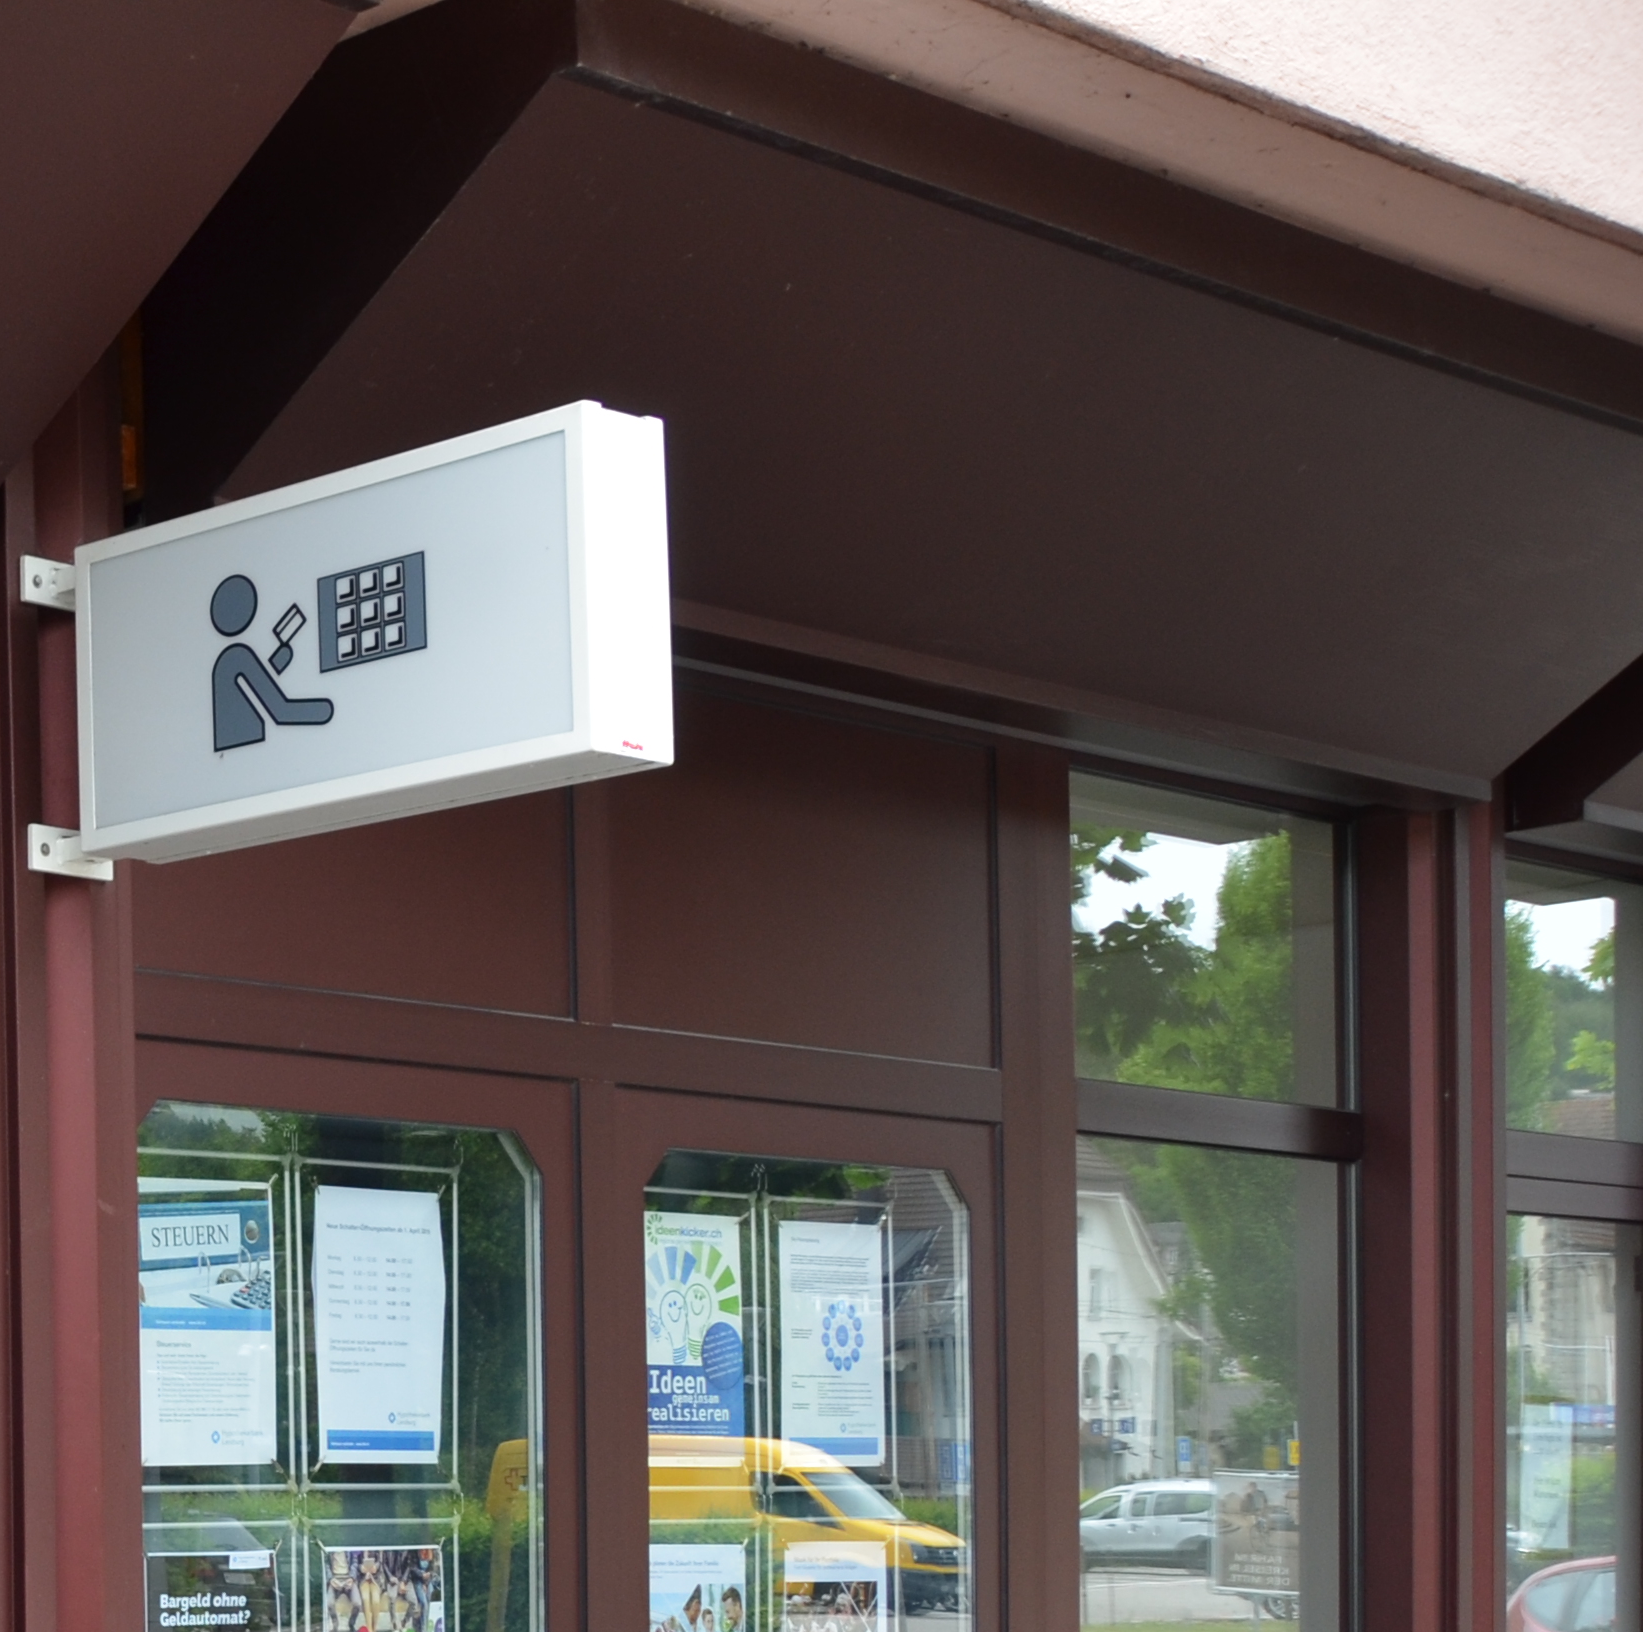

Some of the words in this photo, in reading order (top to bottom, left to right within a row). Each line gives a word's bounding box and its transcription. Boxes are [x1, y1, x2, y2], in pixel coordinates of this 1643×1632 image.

[151, 1224, 230, 1248] STEUERN
[655, 1226, 722, 1238] ideenkicker.ch
[649, 1369, 707, 1394] Ideen
[672, 1392, 720, 1407] gemeinsam
[159, 1593, 211, 1611] Bargeld
[213, 1592, 247, 1607] ohne
[159, 1610, 251, 1627] Geldautomat?
